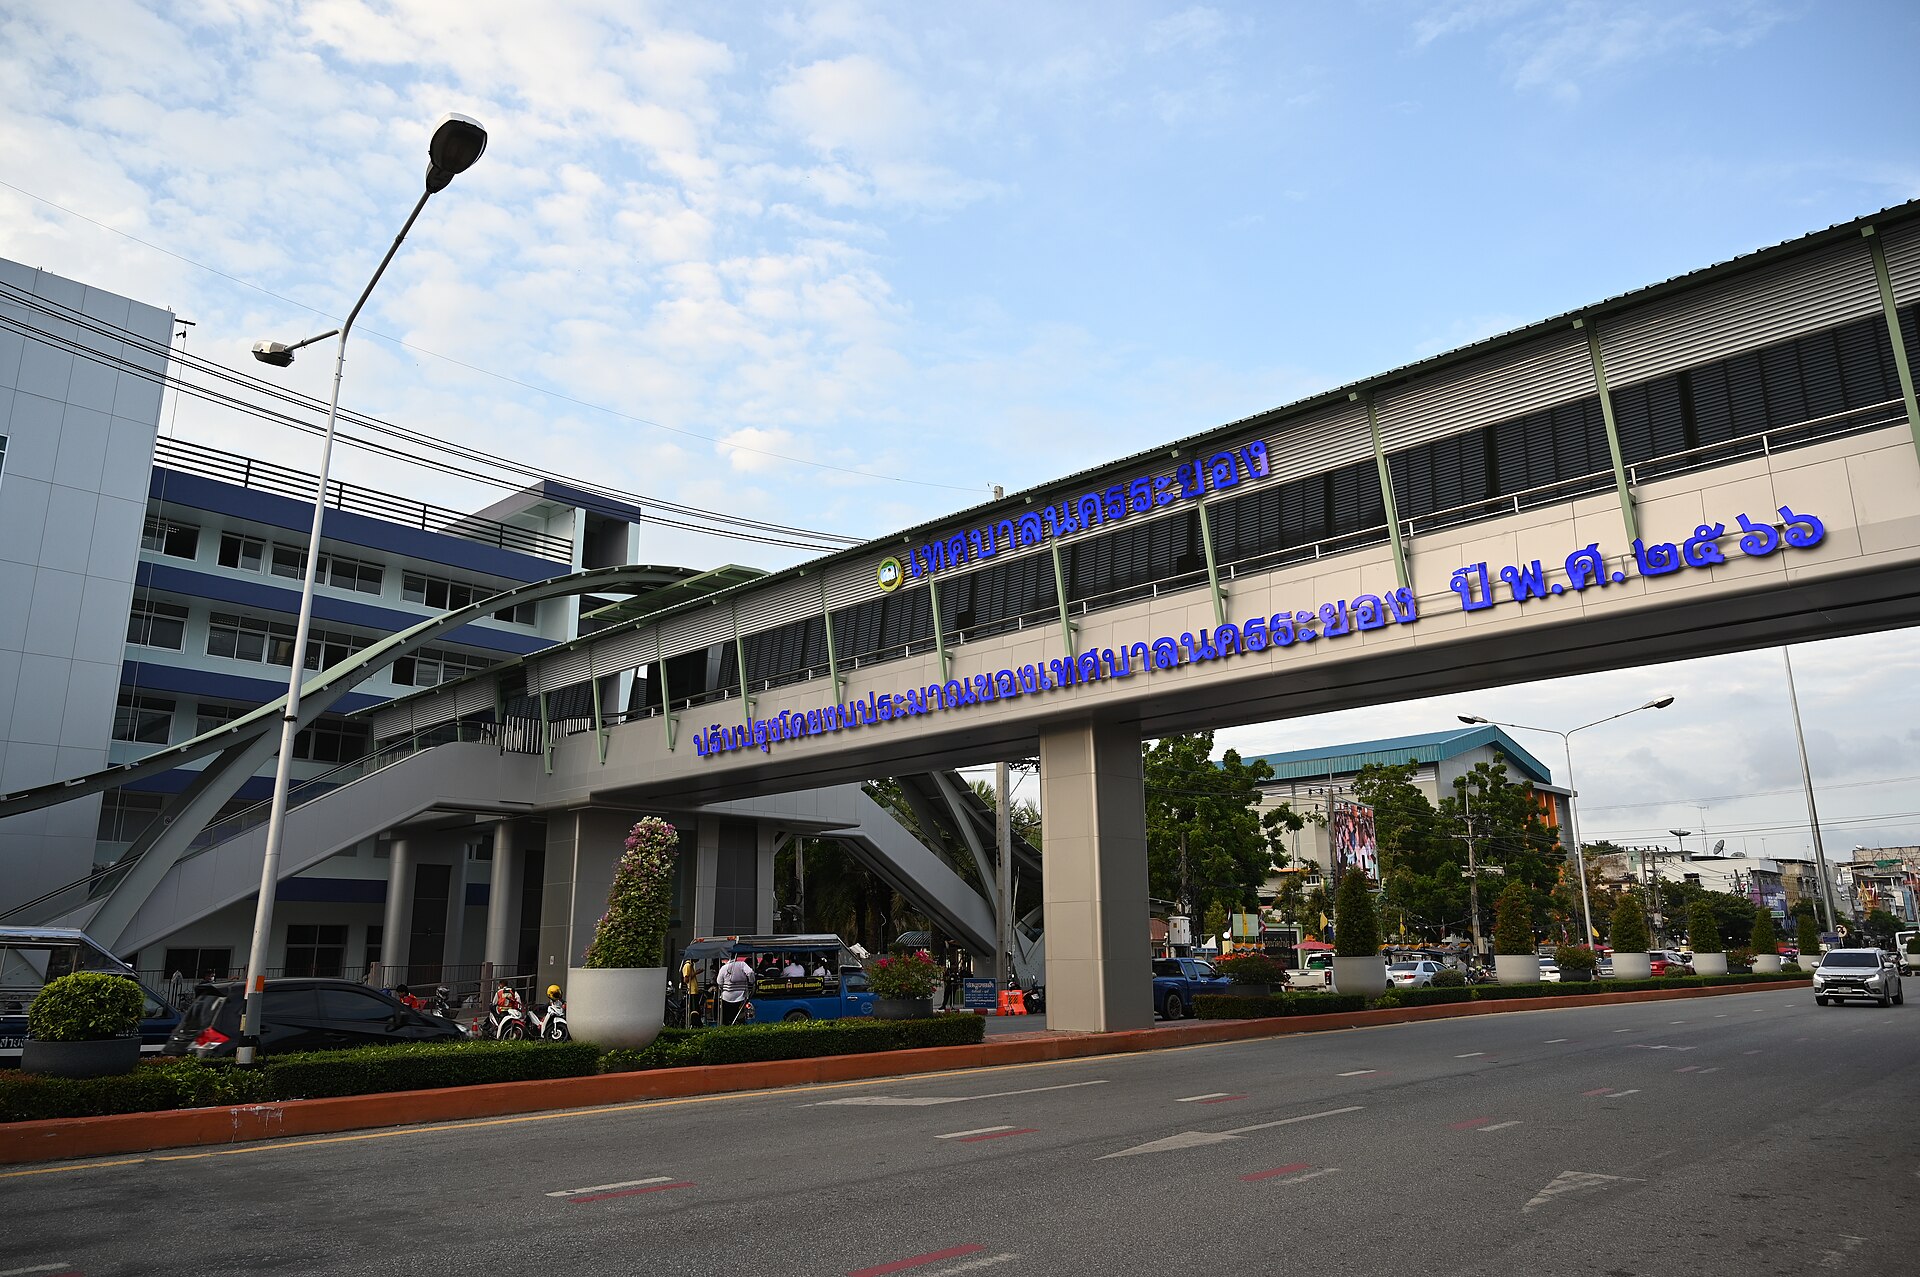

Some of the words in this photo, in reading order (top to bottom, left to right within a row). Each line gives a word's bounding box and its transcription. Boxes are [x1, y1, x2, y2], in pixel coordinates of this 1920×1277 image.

[908, 439, 1270, 578] เทศบาลนครระยอง
